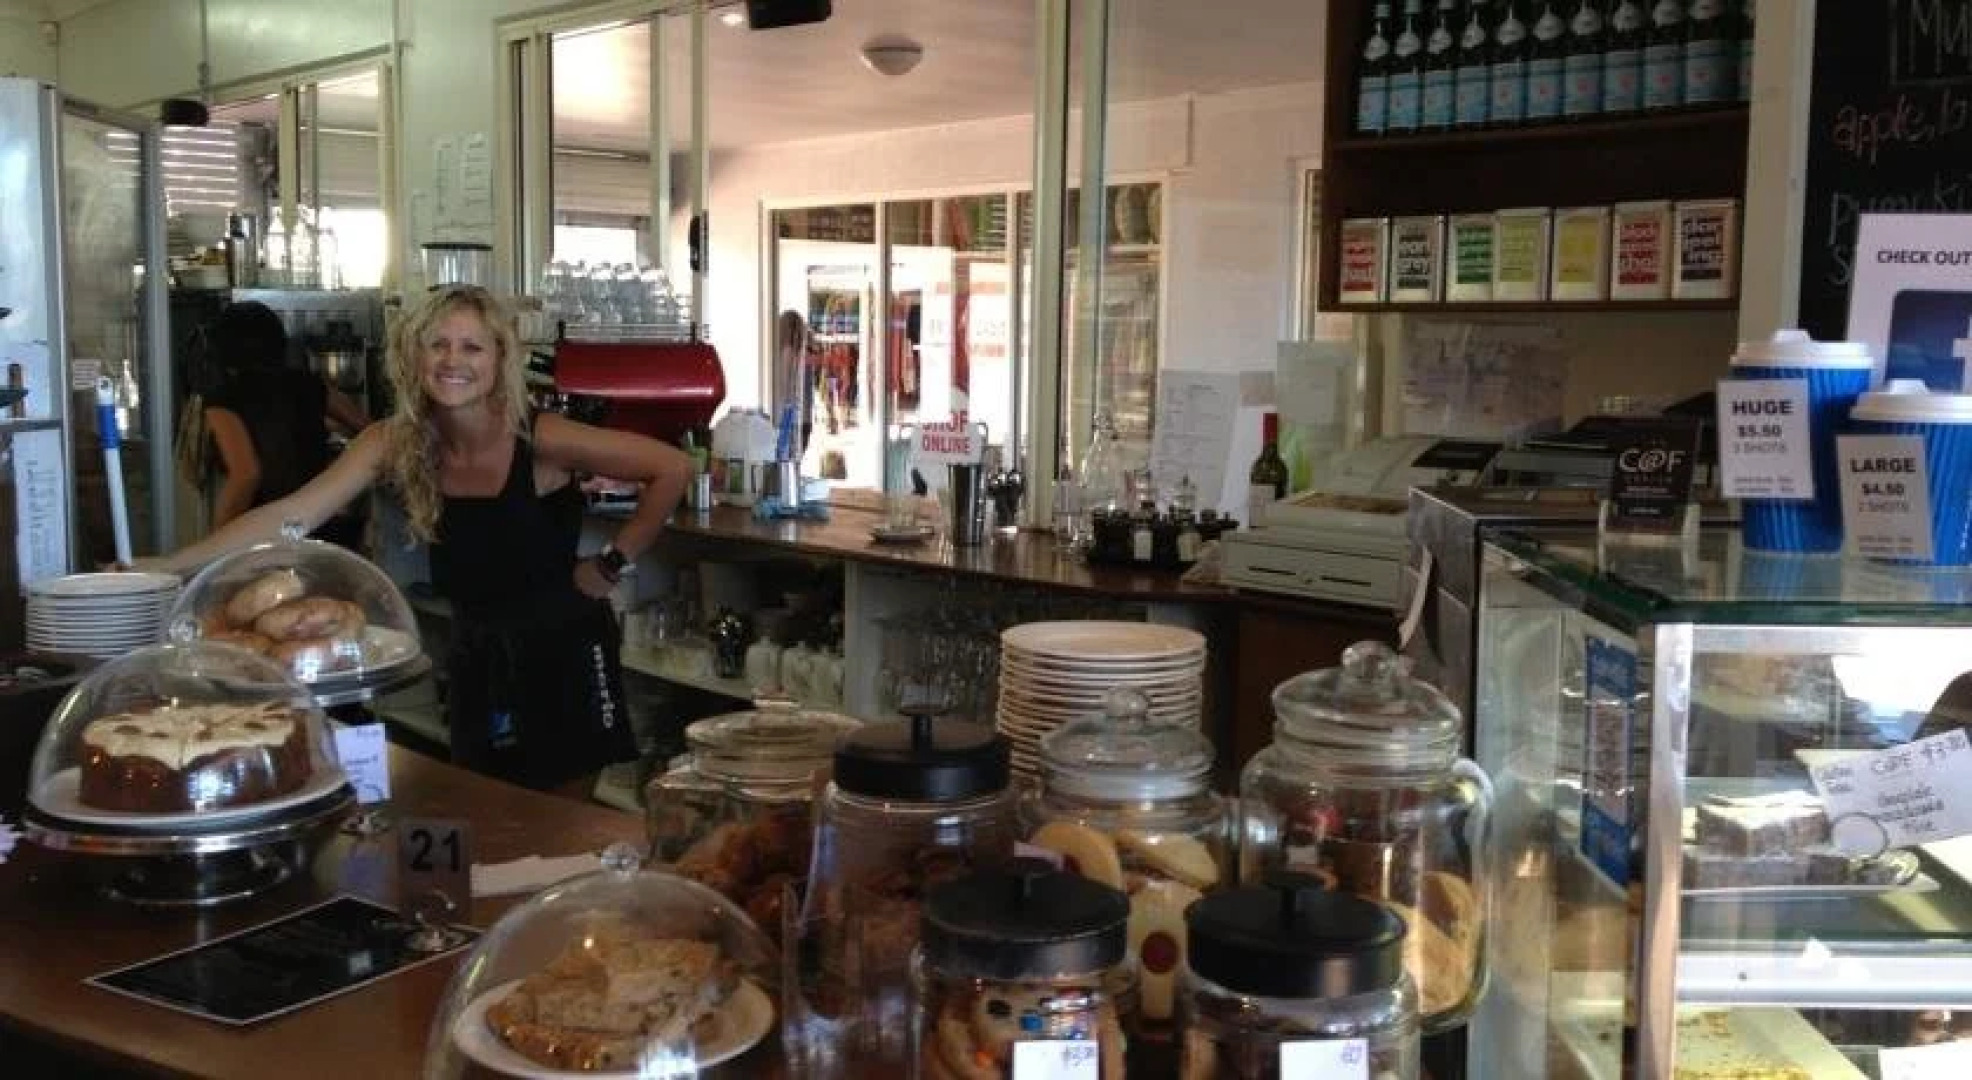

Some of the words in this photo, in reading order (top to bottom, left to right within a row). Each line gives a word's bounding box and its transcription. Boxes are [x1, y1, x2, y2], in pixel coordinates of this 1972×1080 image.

[1909, 0, 1972, 75] Mu
[1877, 249, 1931, 264] CHECK
[1934, 250, 1972, 265] OUT
[1731, 399, 1793, 415] HUGE
[1737, 424, 1782, 437] $5.50
[923, 436, 970, 455] ONLINE
[1743, 442, 1787, 453] SHOTS
[1619, 448, 1687, 473] C@F
[1850, 457, 1917, 473] LARGE
[1861, 483, 1905, 496] $4.50
[409, 828, 461, 873] 21
